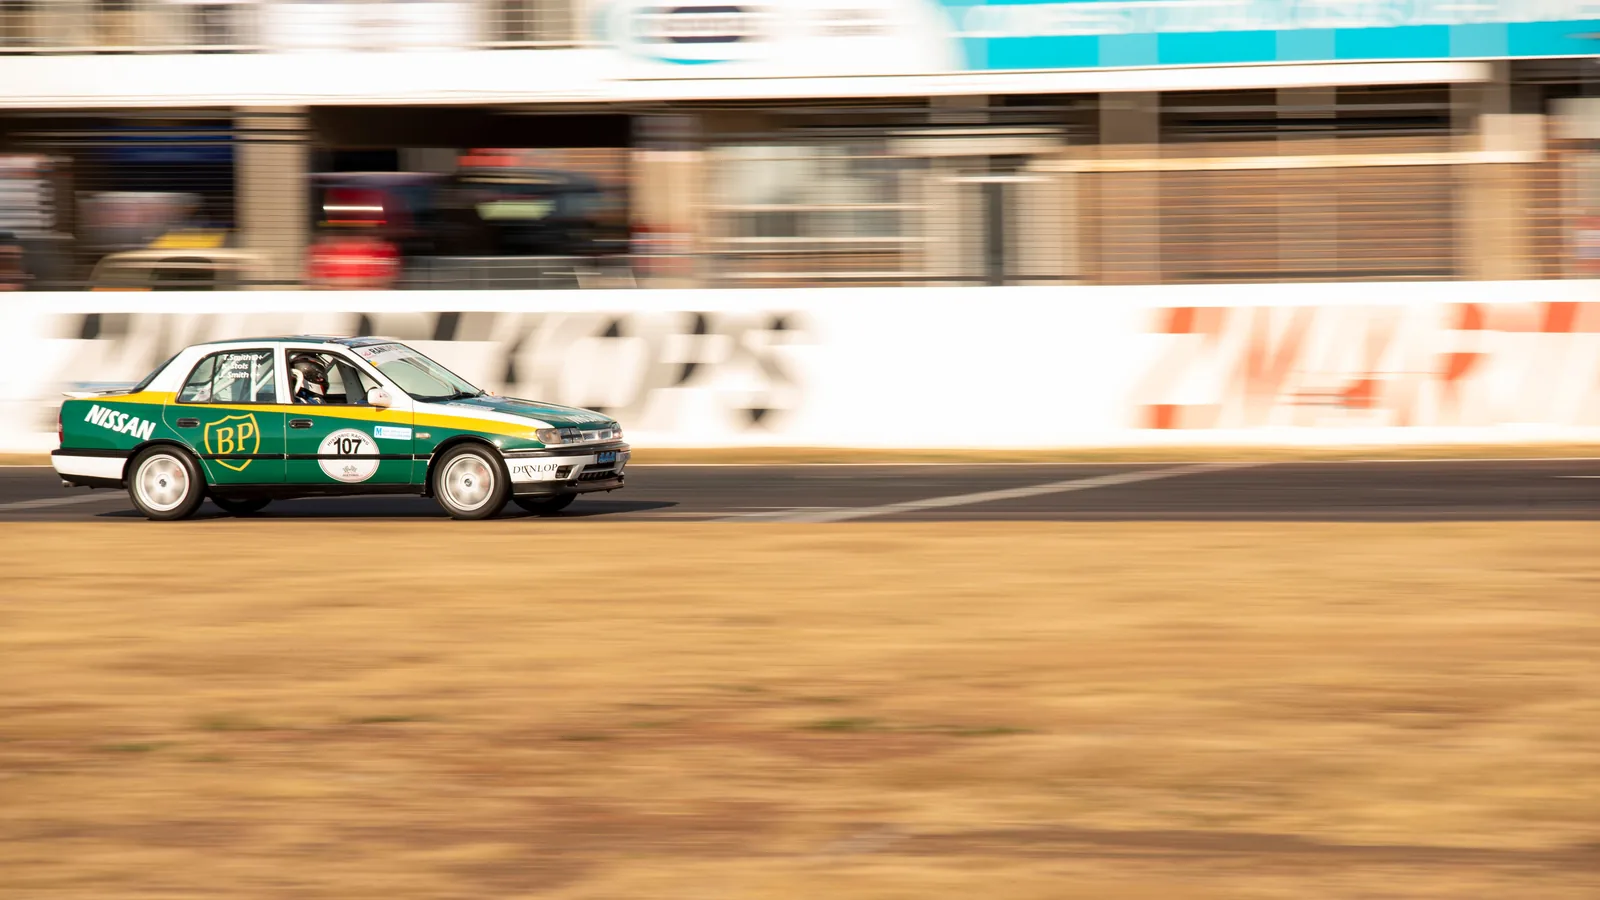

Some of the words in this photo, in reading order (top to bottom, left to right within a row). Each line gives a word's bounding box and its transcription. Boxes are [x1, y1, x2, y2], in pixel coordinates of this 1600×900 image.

[84, 404, 156, 441] NISSAN
[216, 423, 254, 454] BP
[333, 437, 362, 454] 107
[513, 463, 558, 478] DUNLOP
